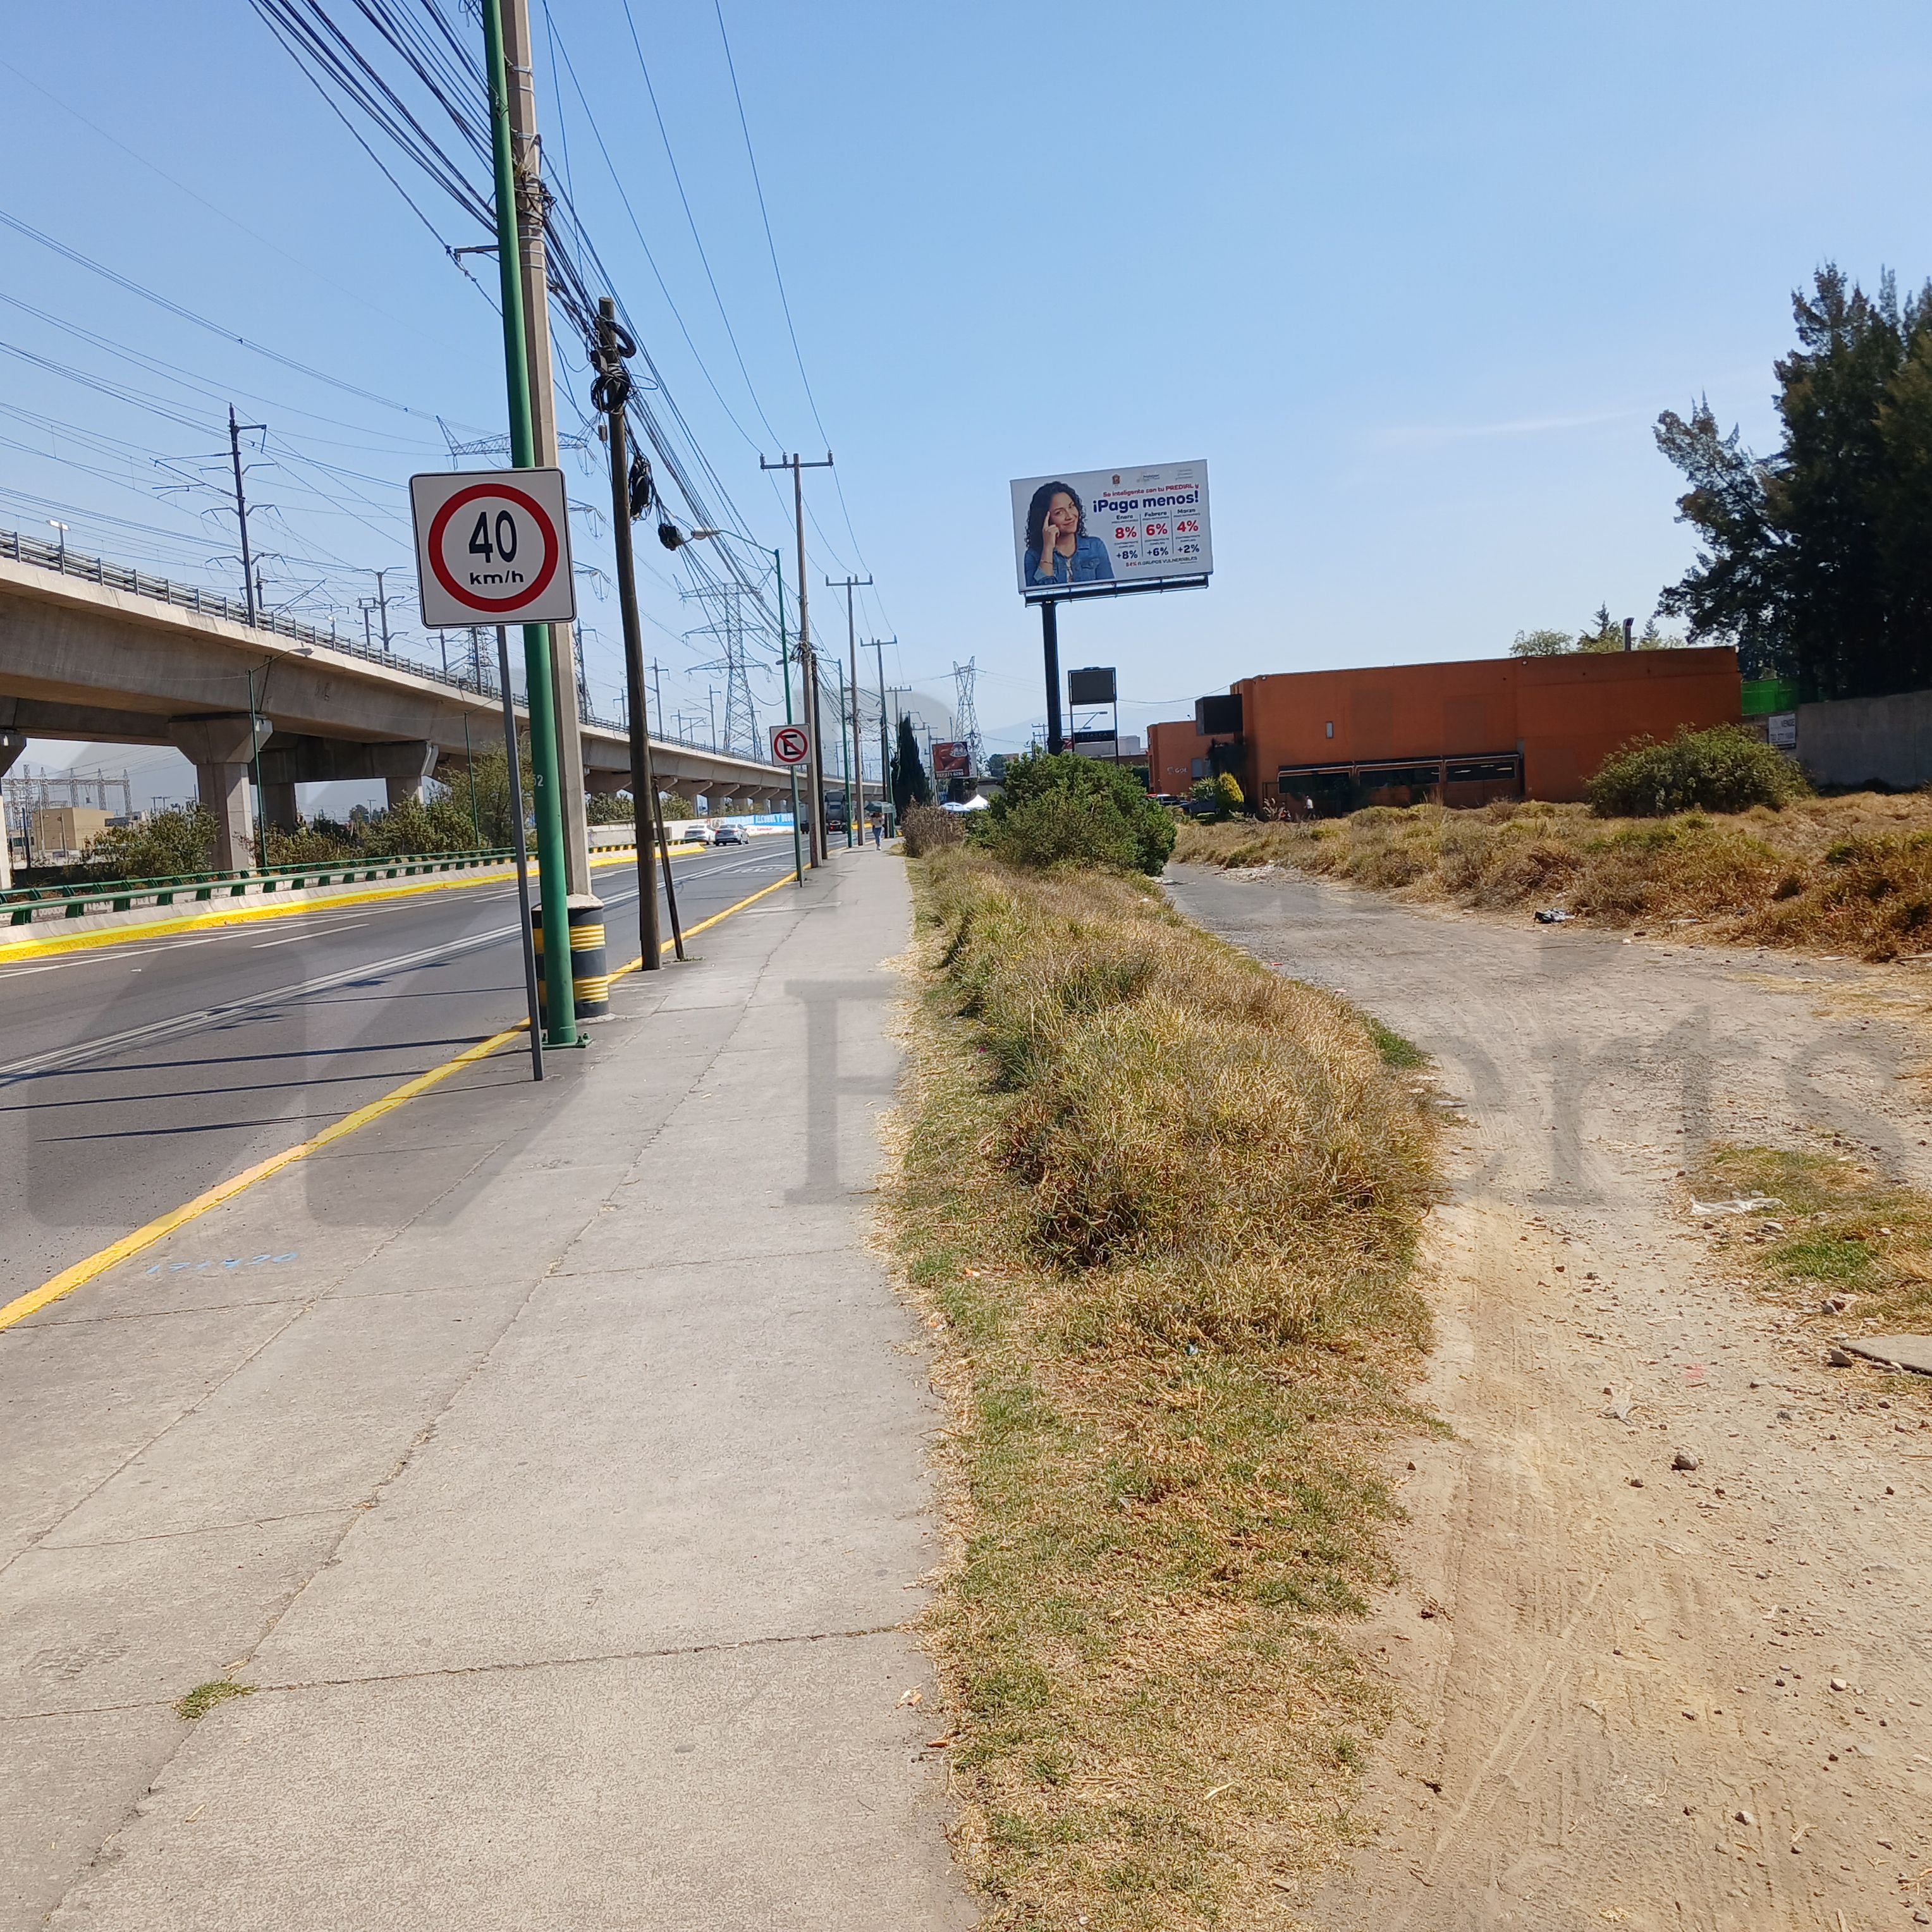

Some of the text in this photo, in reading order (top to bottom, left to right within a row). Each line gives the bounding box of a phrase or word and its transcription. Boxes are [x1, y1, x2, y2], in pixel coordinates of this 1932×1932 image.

[1165, 483, 1194, 492] PREDIAL
[1092, 489, 1199, 513] ¡Paga menos!
[1115, 526, 1137, 539] 8%
[1146, 523, 1168, 536] 6%
[1177, 520, 1199, 532] 4%
[468, 510, 518, 563] 40
[1116, 549, 1138, 559] +8%
[1147, 546, 1169, 556] +6%
[1178, 544, 1200, 554] +2%
[470, 570, 524, 585] km/h
[782, 734, 801, 756] E
